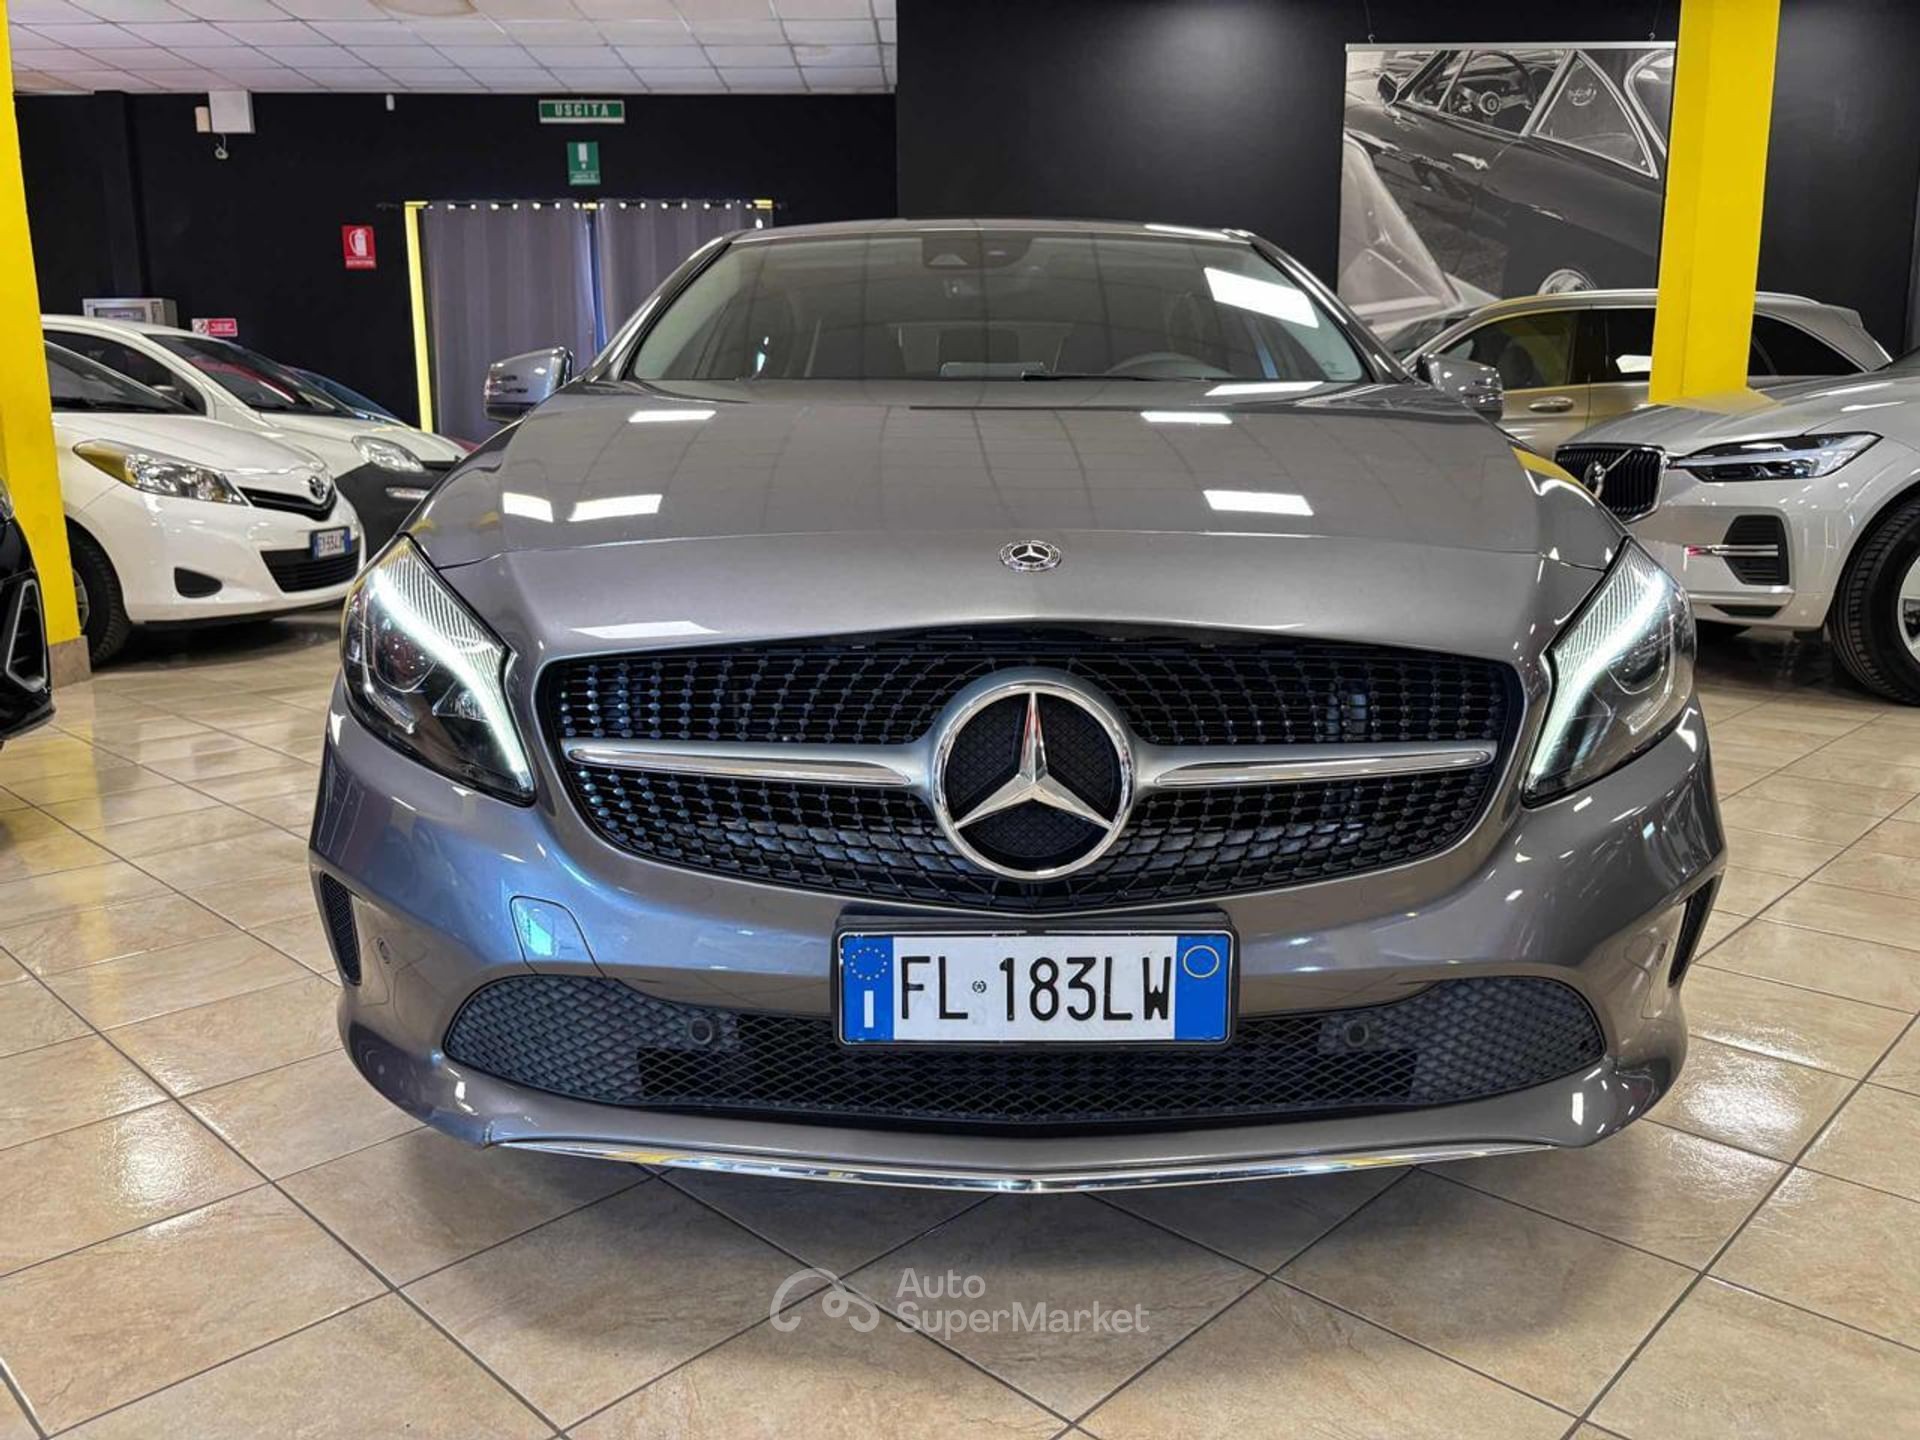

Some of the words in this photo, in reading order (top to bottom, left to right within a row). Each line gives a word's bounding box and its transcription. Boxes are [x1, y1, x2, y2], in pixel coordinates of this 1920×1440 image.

[554, 103, 609, 117] USCITA
[901, 956, 968, 1020] FL
[999, 956, 1172, 1021] 183LW
